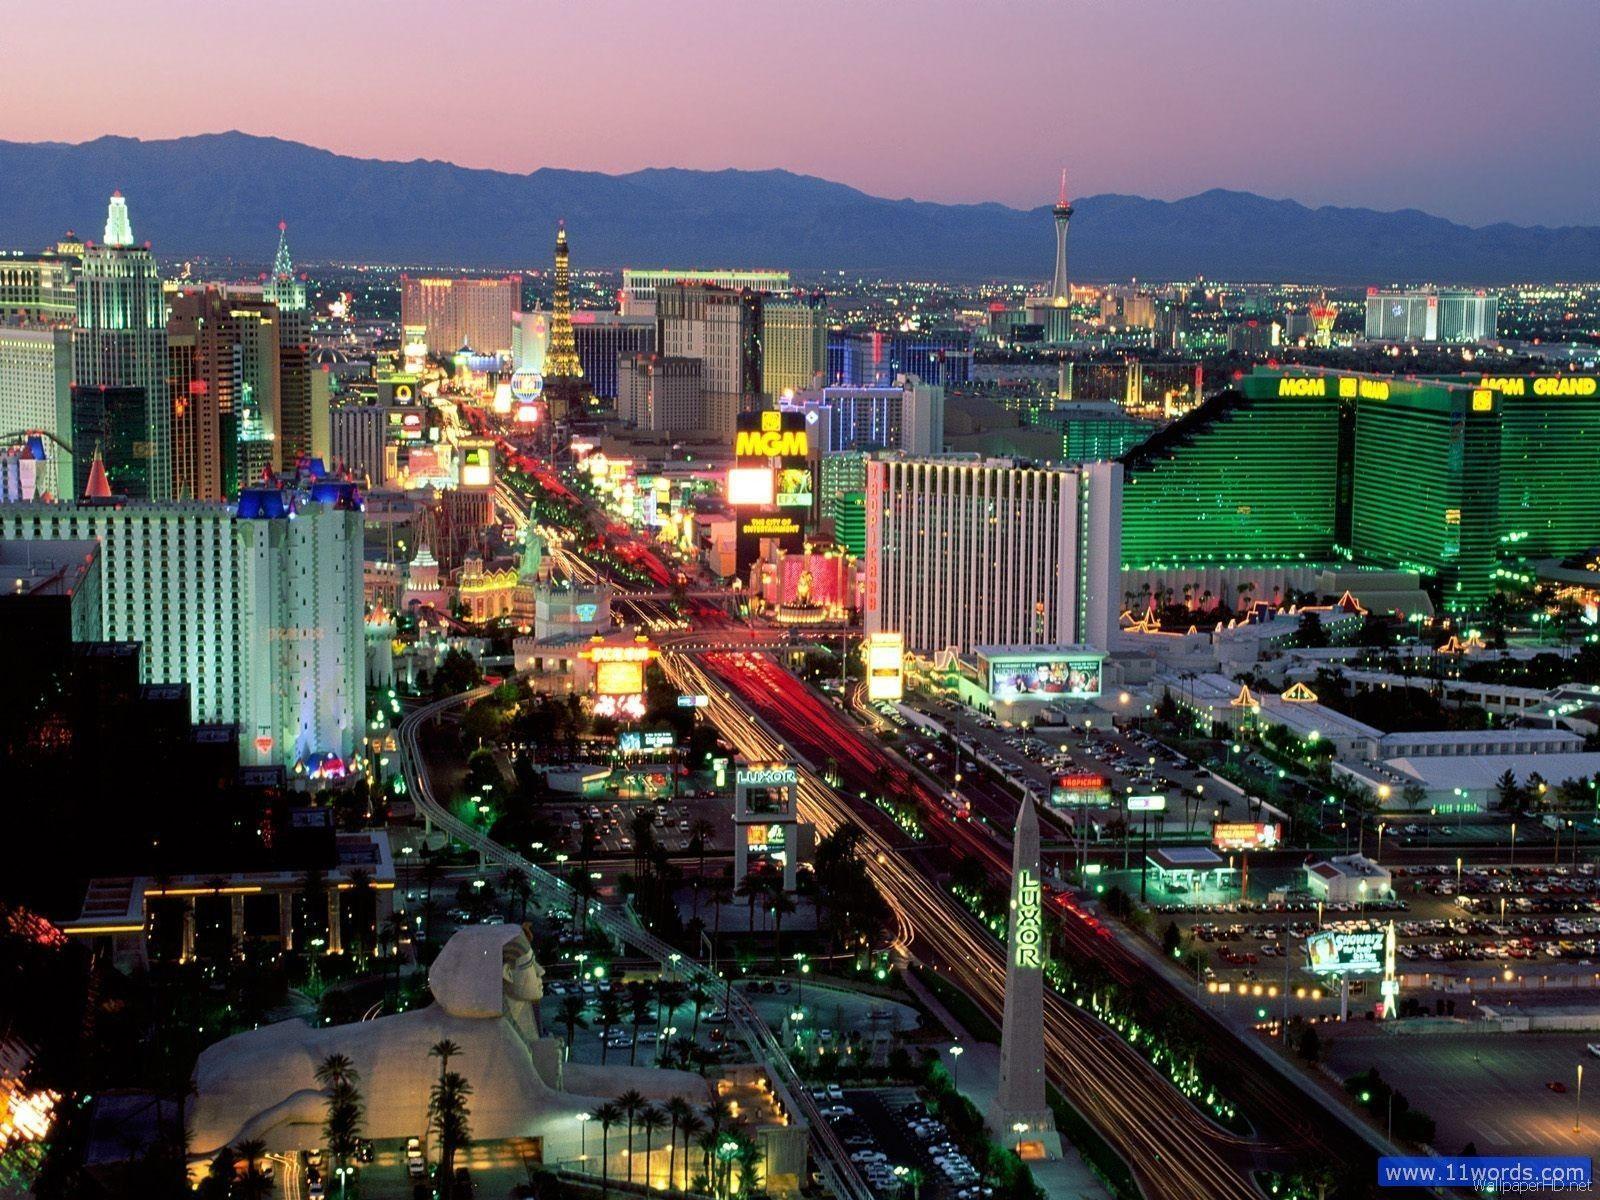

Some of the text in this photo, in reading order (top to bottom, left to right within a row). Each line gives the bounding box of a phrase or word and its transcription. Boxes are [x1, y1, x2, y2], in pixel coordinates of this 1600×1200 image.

[1278, 378, 1325, 396] MGM
[1532, 377, 1597, 396] GRAND
[735, 431, 809, 457] MGM
[743, 525, 800, 534] ENTERTAINMENT
[765, 518, 781, 526] CITY
[737, 770, 797, 784] LUXOR
[1062, 778, 1101, 787] TROPICANA
[1018, 870, 1041, 967] LUXOR
